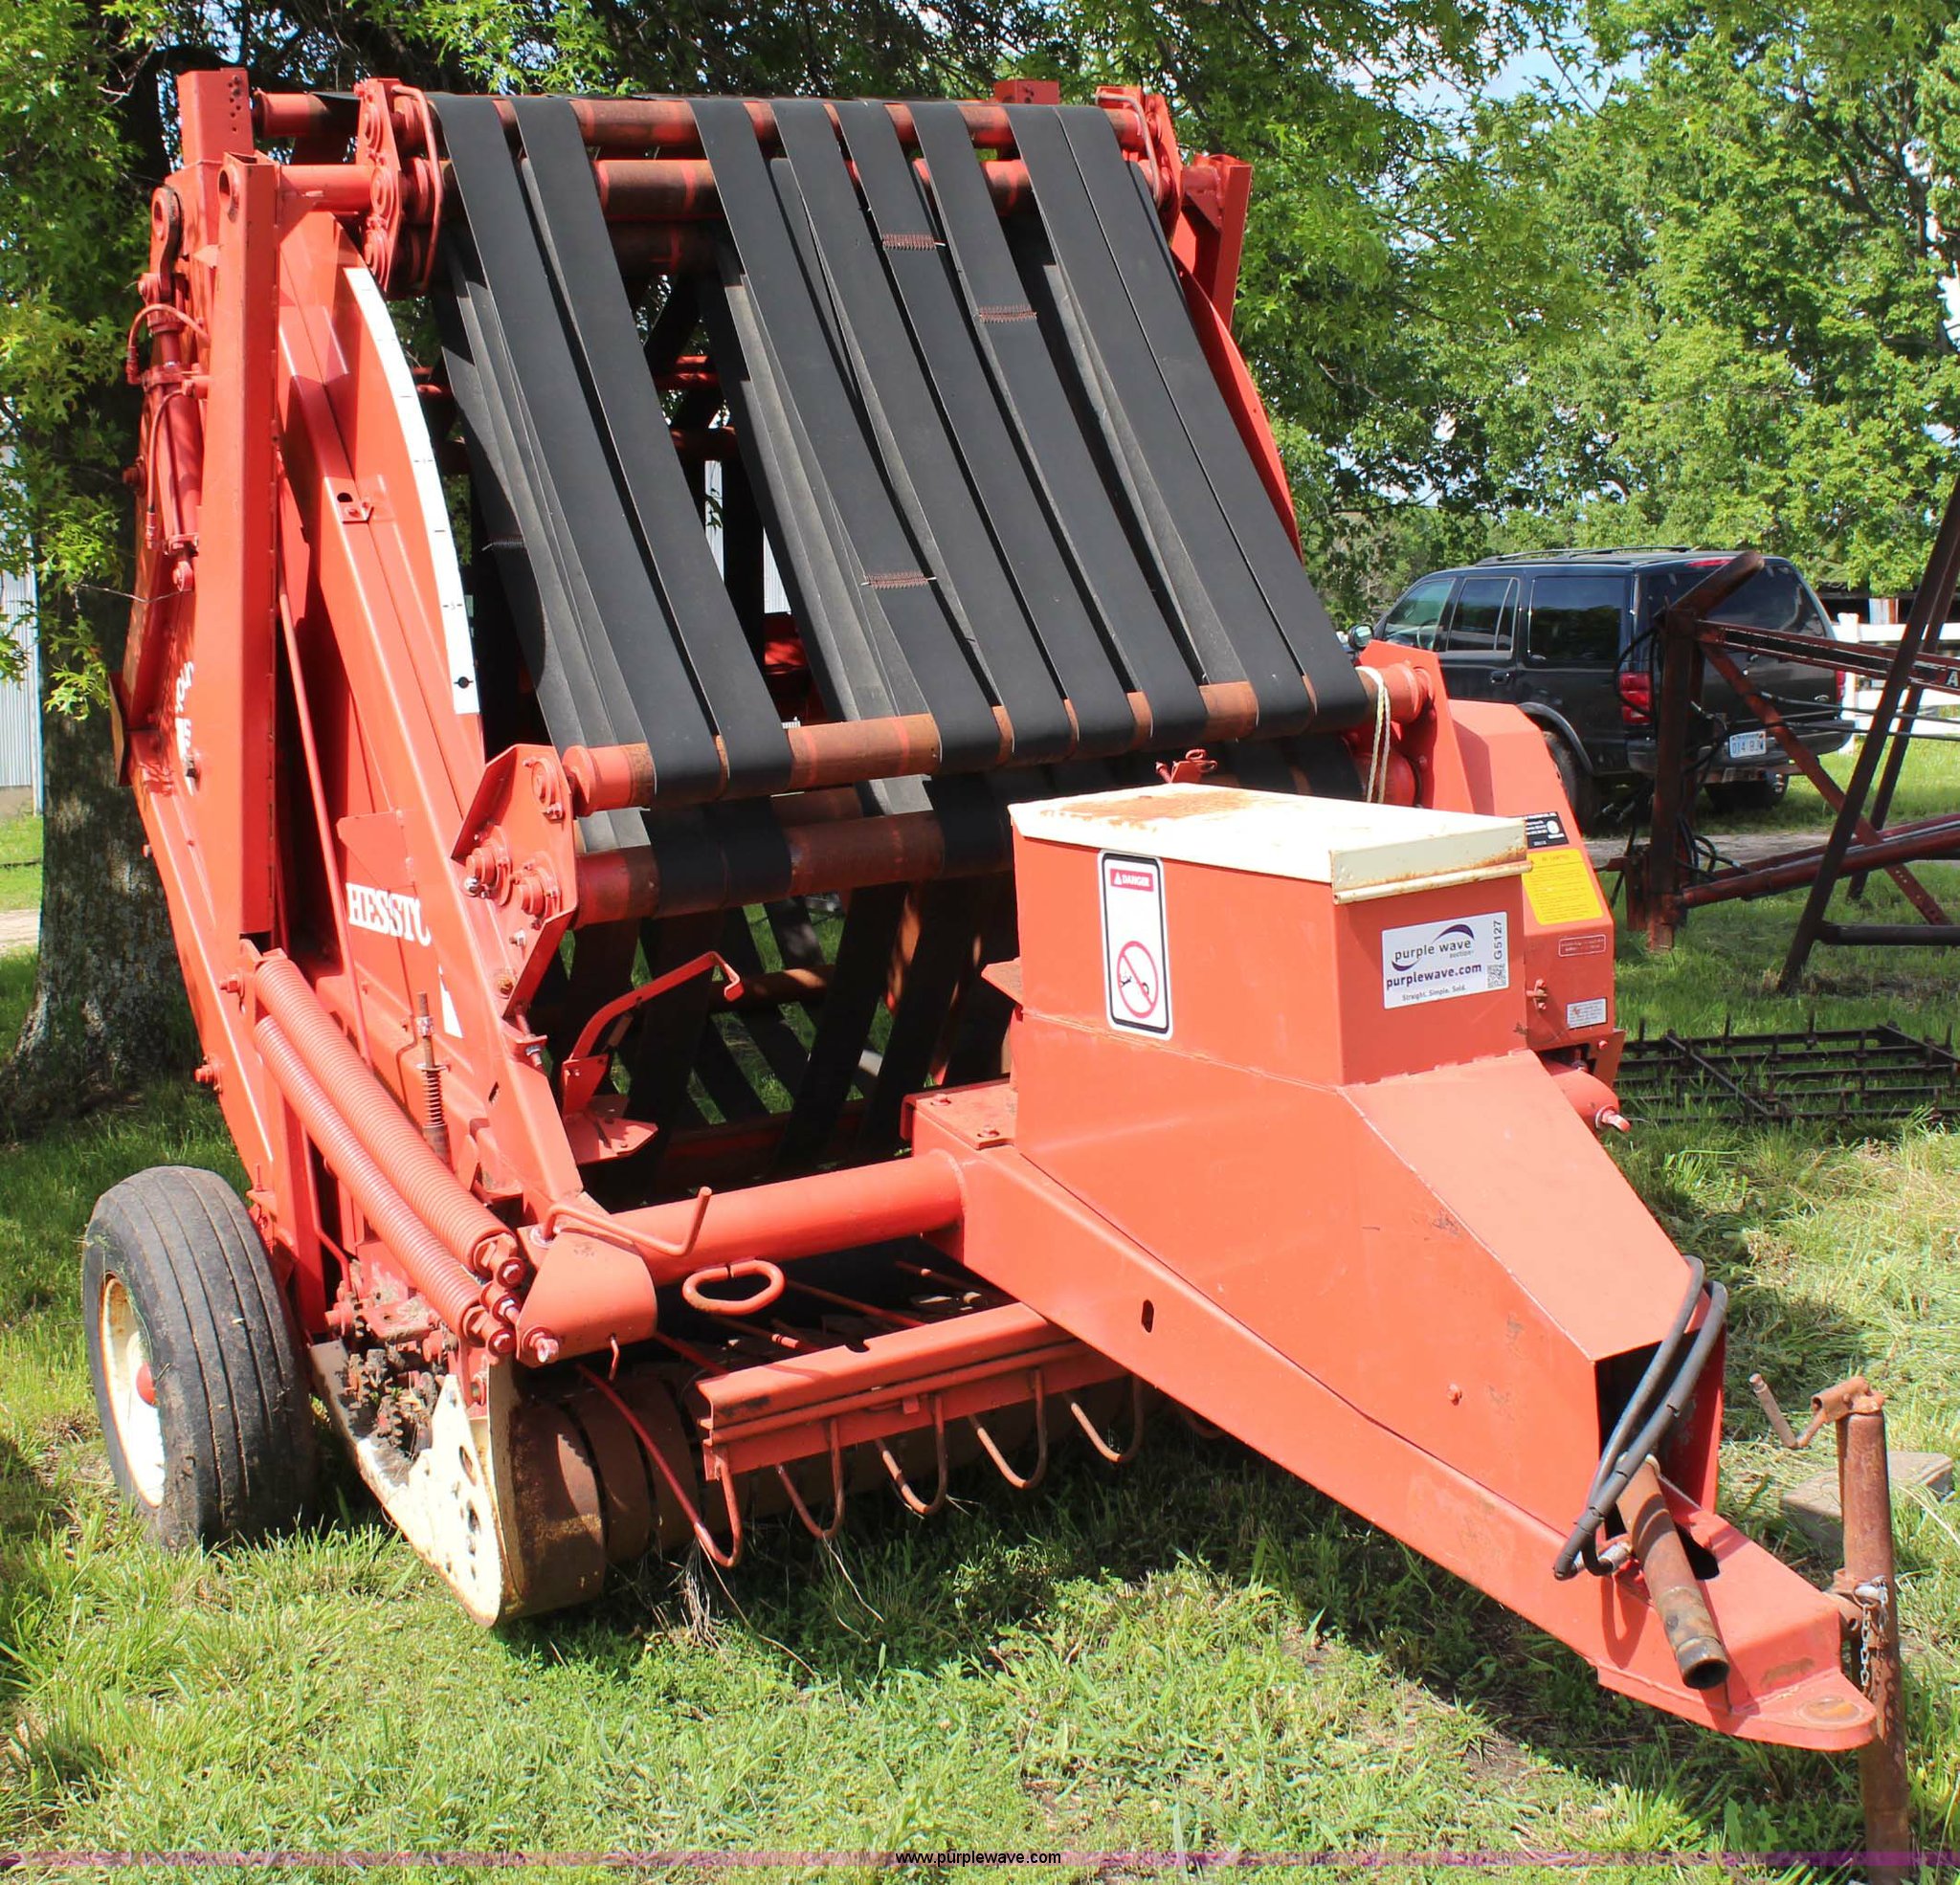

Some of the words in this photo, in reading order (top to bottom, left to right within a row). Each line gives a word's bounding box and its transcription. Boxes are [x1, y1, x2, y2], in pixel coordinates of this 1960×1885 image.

[1121, 874, 1151, 887] DANGER
[1394, 944, 1435, 962] purple
[1438, 940, 1471, 952] wave
[1493, 920, 1503, 960] G5127
[1387, 964, 1481, 990] purplewave.com
